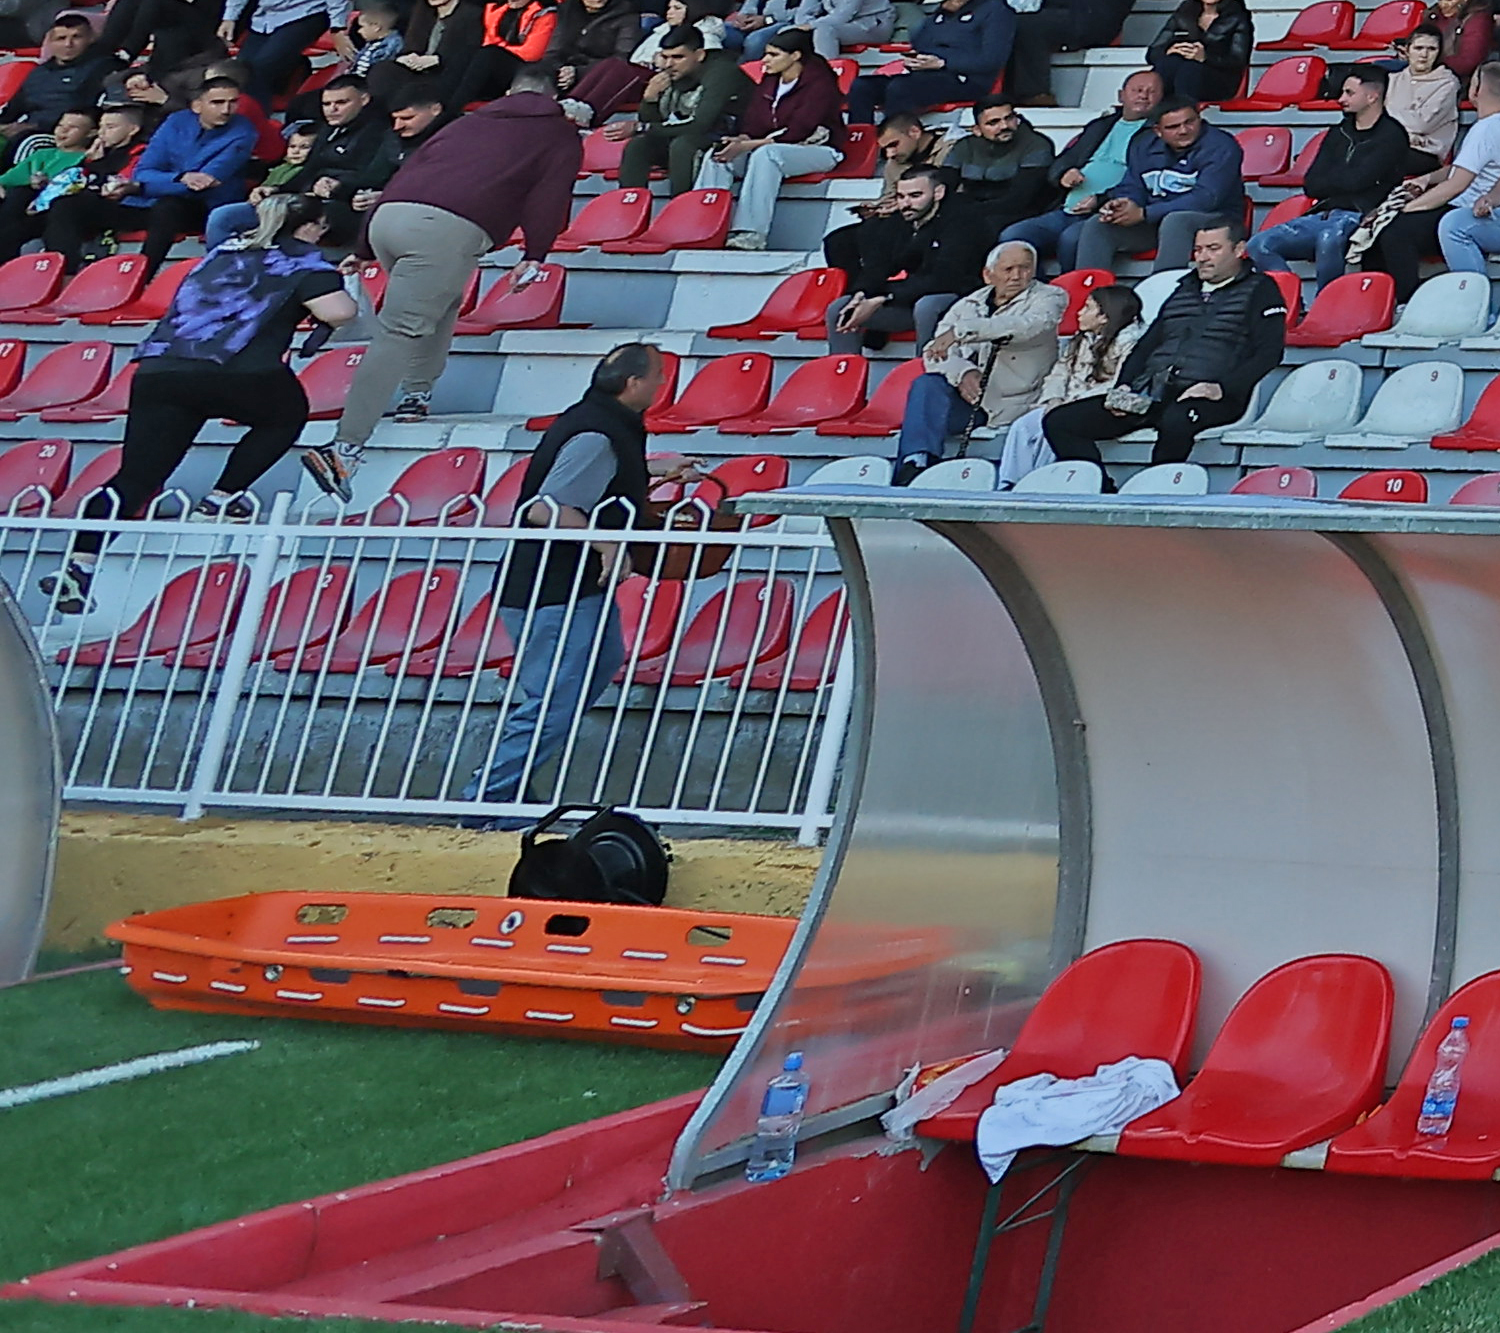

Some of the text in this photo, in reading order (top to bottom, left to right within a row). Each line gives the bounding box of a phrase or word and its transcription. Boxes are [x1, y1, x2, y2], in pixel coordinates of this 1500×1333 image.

[1332, 6, 1338, 15] 1
[1401, 4, 1410, 14] 2
[1297, 62, 1307, 73] 2
[850, 131, 863, 142] 21
[1265, 135, 1274, 146] 3
[703, 193, 718, 204] 21
[818, 274, 826, 285] 1
[1083, 275, 1093, 287] 4
[1362, 278, 1372, 291] 7
[1458, 279, 1467, 291] 8
[742, 359, 752, 371] 2
[836, 361, 847, 374] 3
[1327, 368, 1338, 381] 8
[1430, 370, 1439, 382] 9
[456, 455, 465, 467] 1
[754, 460, 765, 473] 4
[859, 464, 870, 477] 5
[961, 467, 971, 480] 6
[1066, 469, 1077, 482] 7
[1172, 471, 1183, 485] 8
[1279, 473, 1291, 488] 9
[1386, 478, 1402, 493] 10
[217, 572, 226, 585] 1
[320, 573, 334, 588] 2
[429, 576, 440, 590] 3
